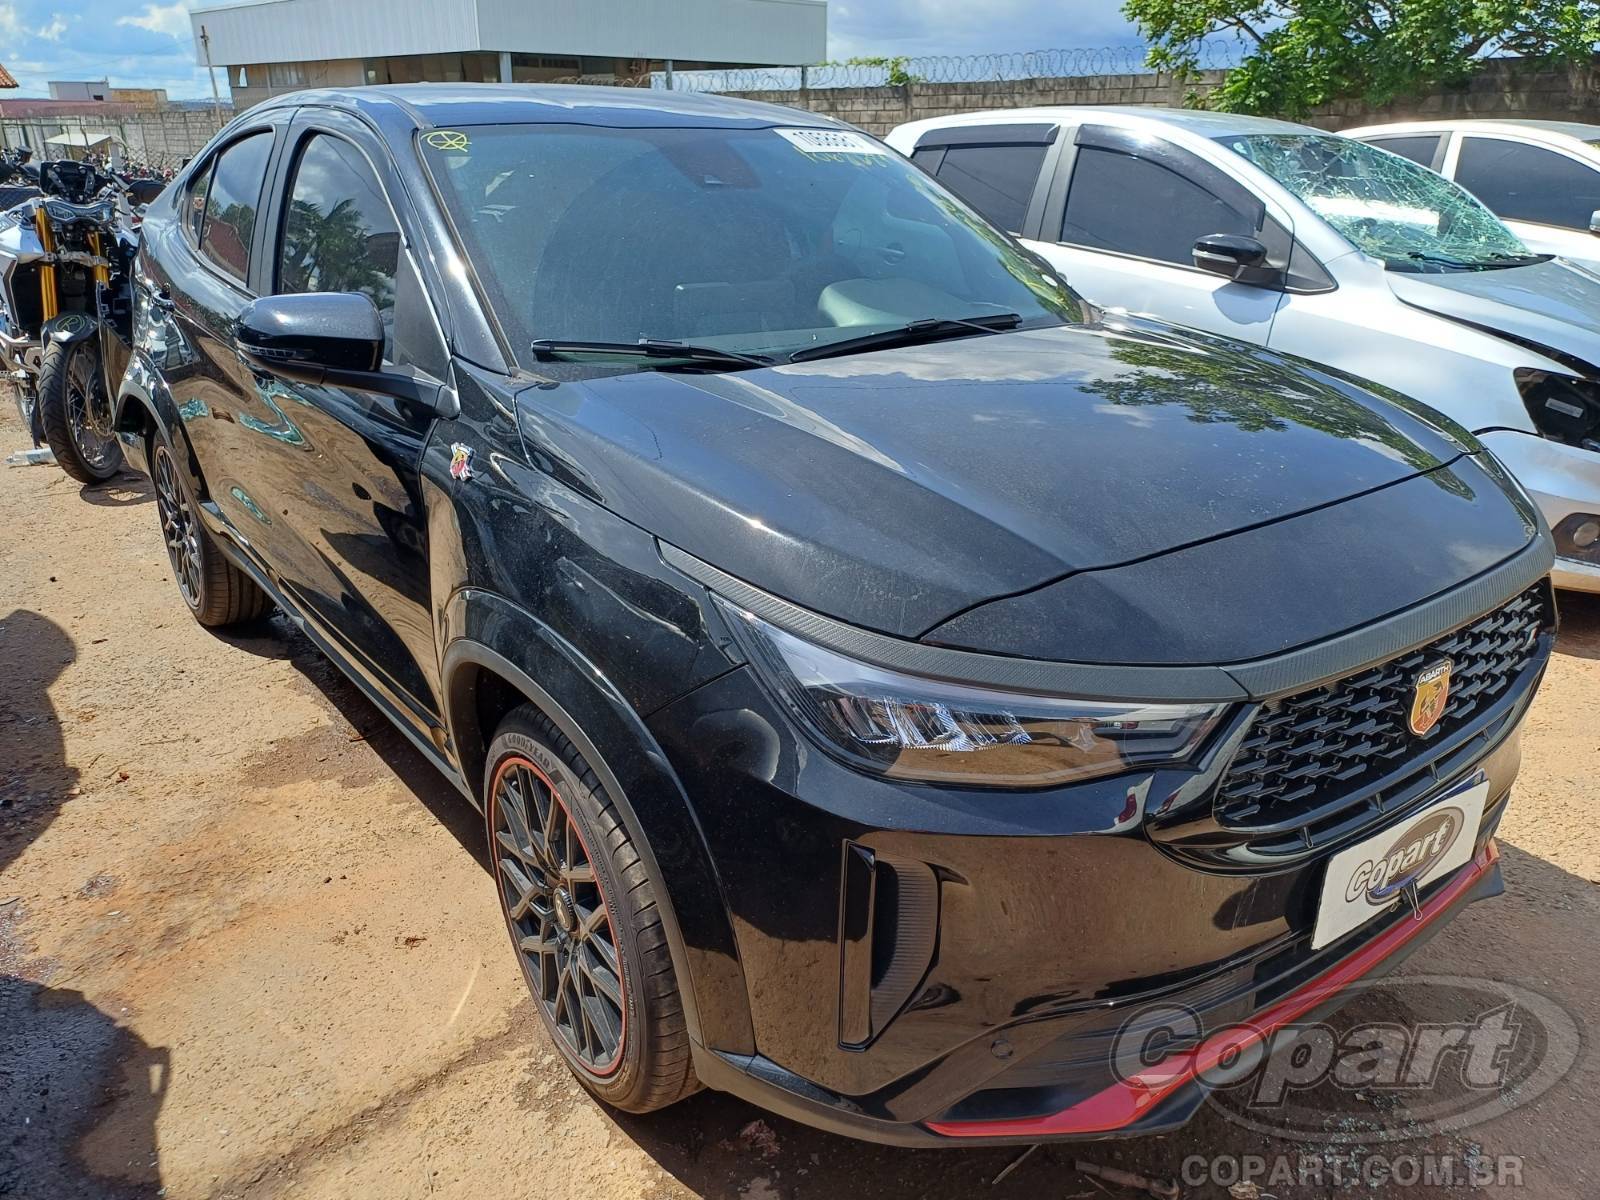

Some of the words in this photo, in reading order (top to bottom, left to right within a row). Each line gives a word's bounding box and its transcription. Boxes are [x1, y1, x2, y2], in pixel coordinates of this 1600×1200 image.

[1420, 664, 1449, 682] ABARTH
[507, 734, 550, 769] GOODYEAR
[1345, 815, 1452, 903] Copart
